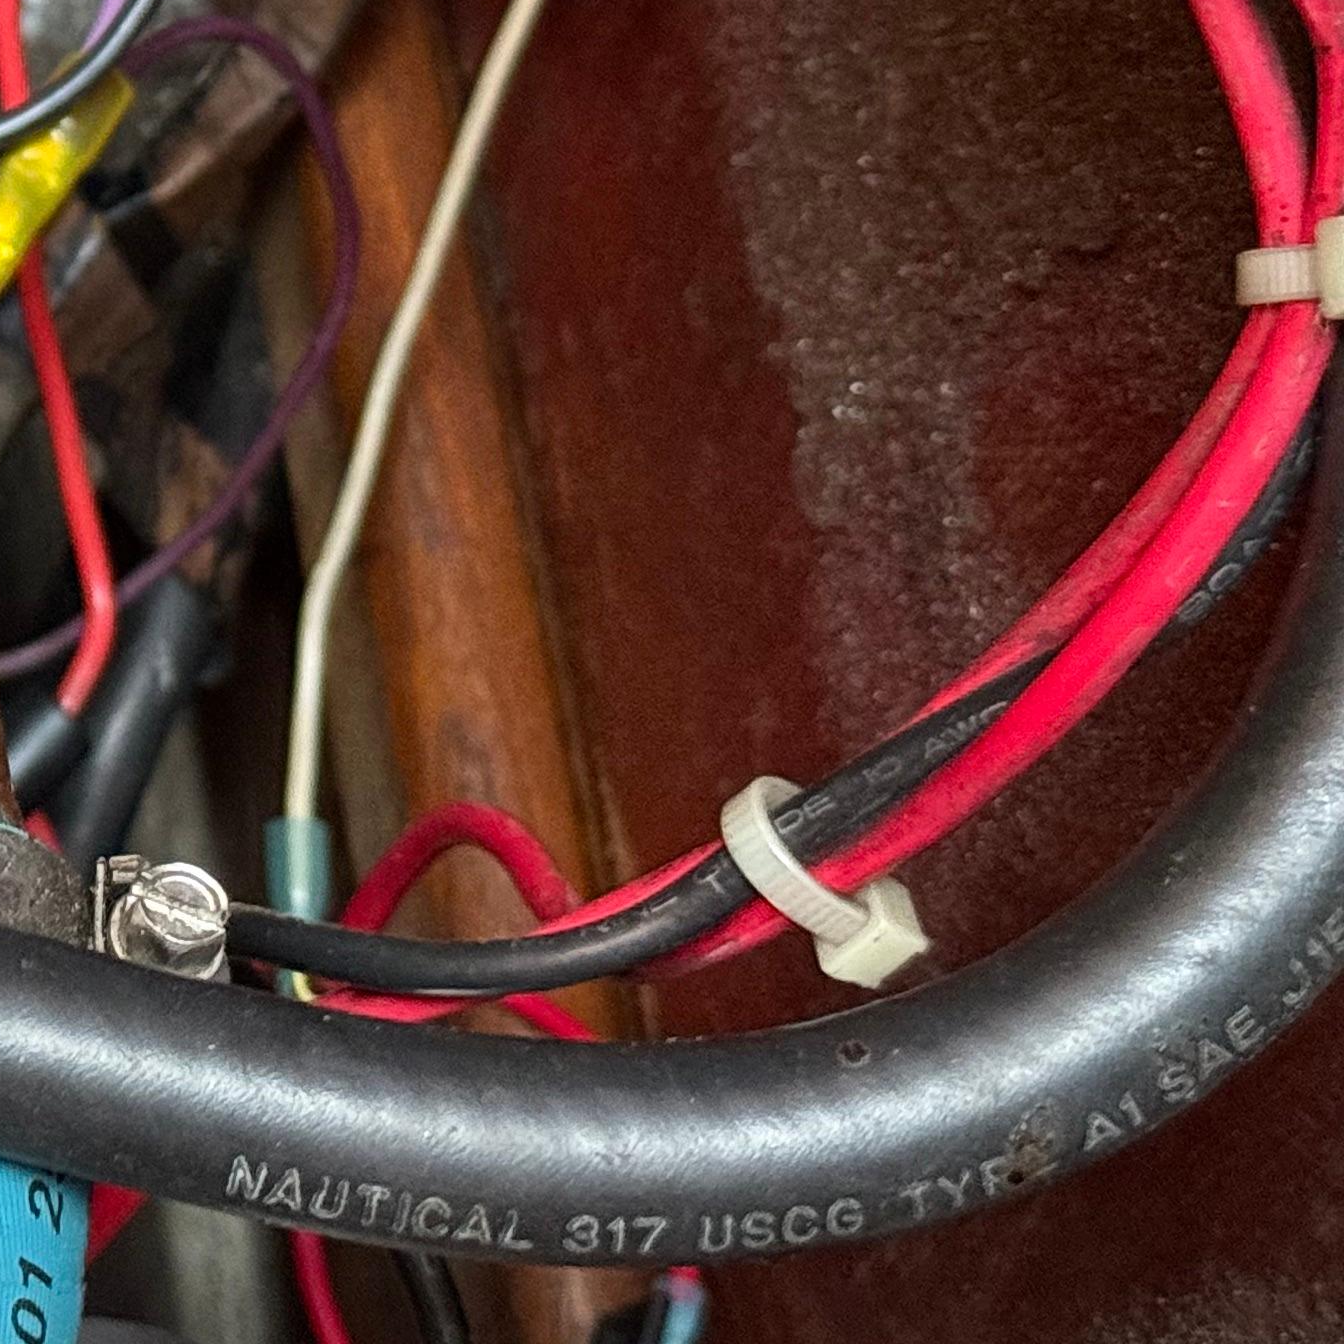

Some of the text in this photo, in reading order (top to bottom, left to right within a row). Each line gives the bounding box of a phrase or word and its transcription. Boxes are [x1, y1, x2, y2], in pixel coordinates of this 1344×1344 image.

[225, 1154, 534, 1253] NAUTICAL
[562, 1213, 672, 1256] 317
[698, 1196, 866, 1254] USCG
[1157, 1003, 1269, 1105] SAE
